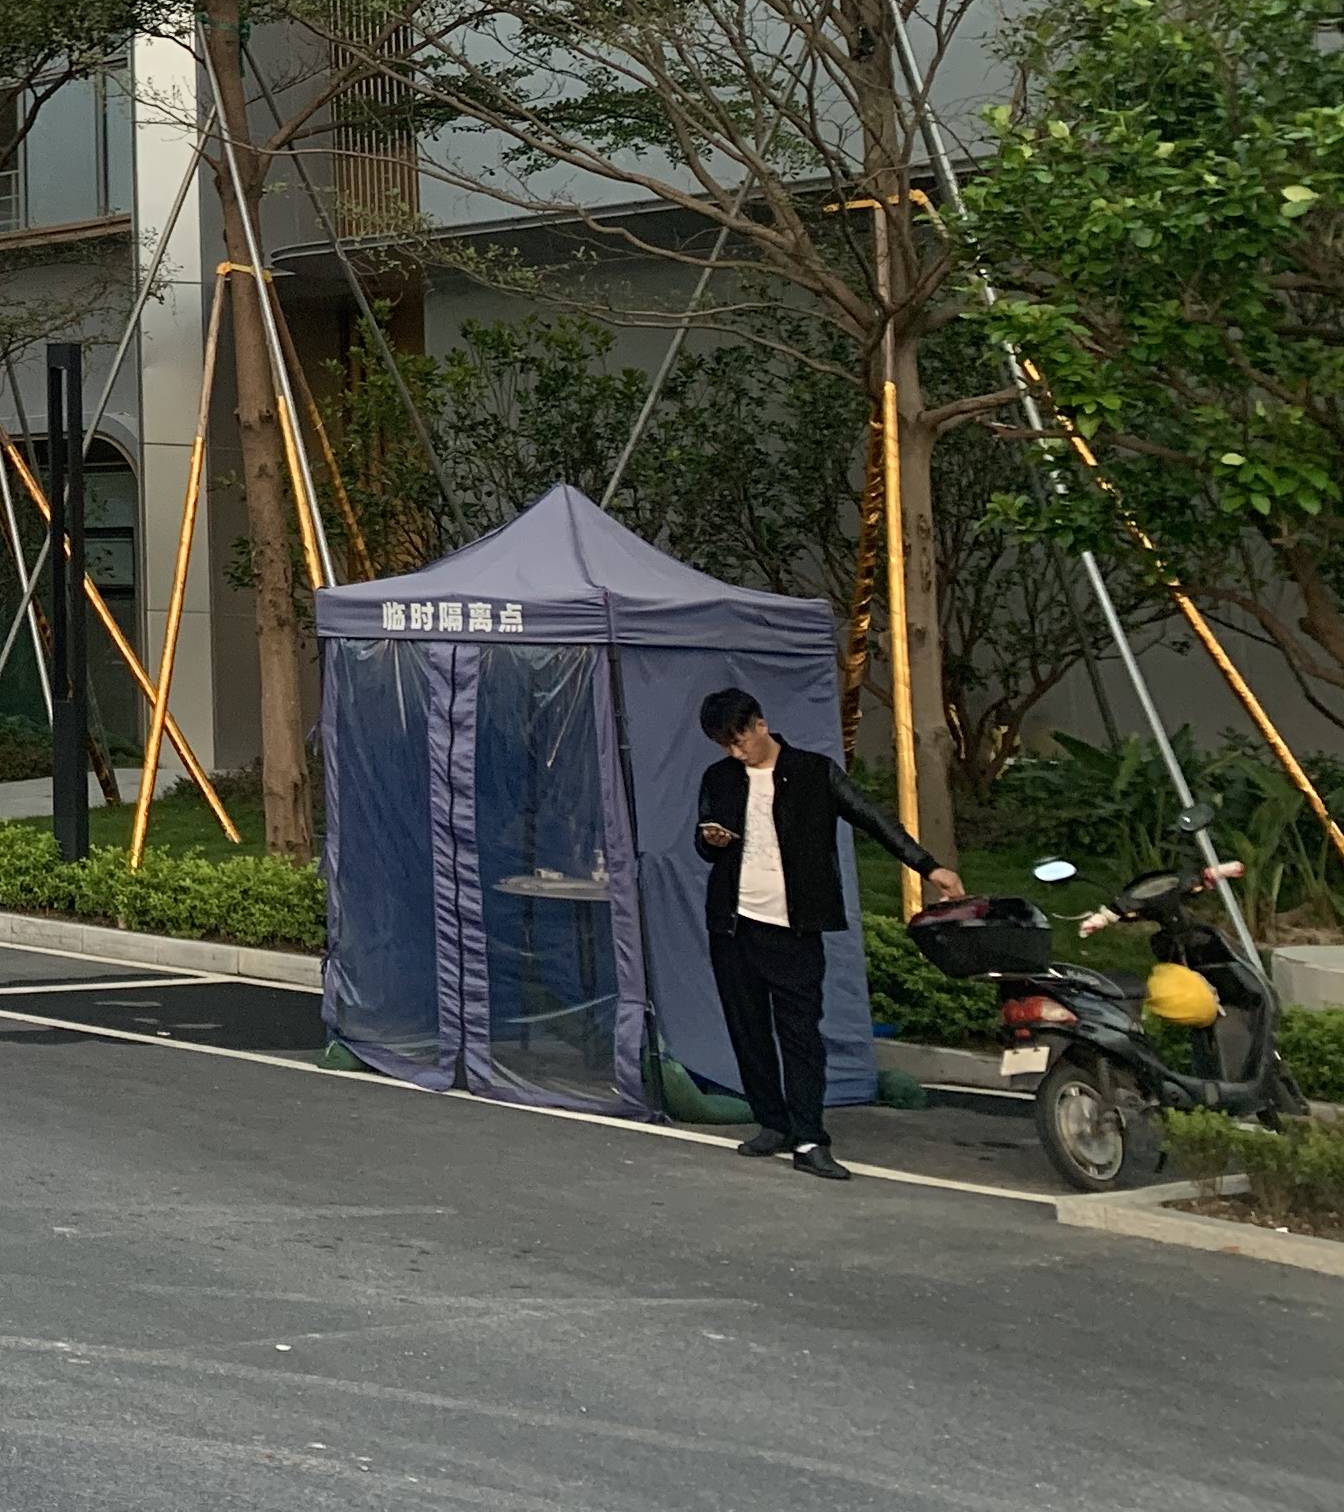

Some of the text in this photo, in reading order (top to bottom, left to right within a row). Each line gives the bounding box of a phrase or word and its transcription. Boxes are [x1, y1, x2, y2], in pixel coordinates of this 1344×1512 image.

[382, 601, 524, 633] 临时隔离点
